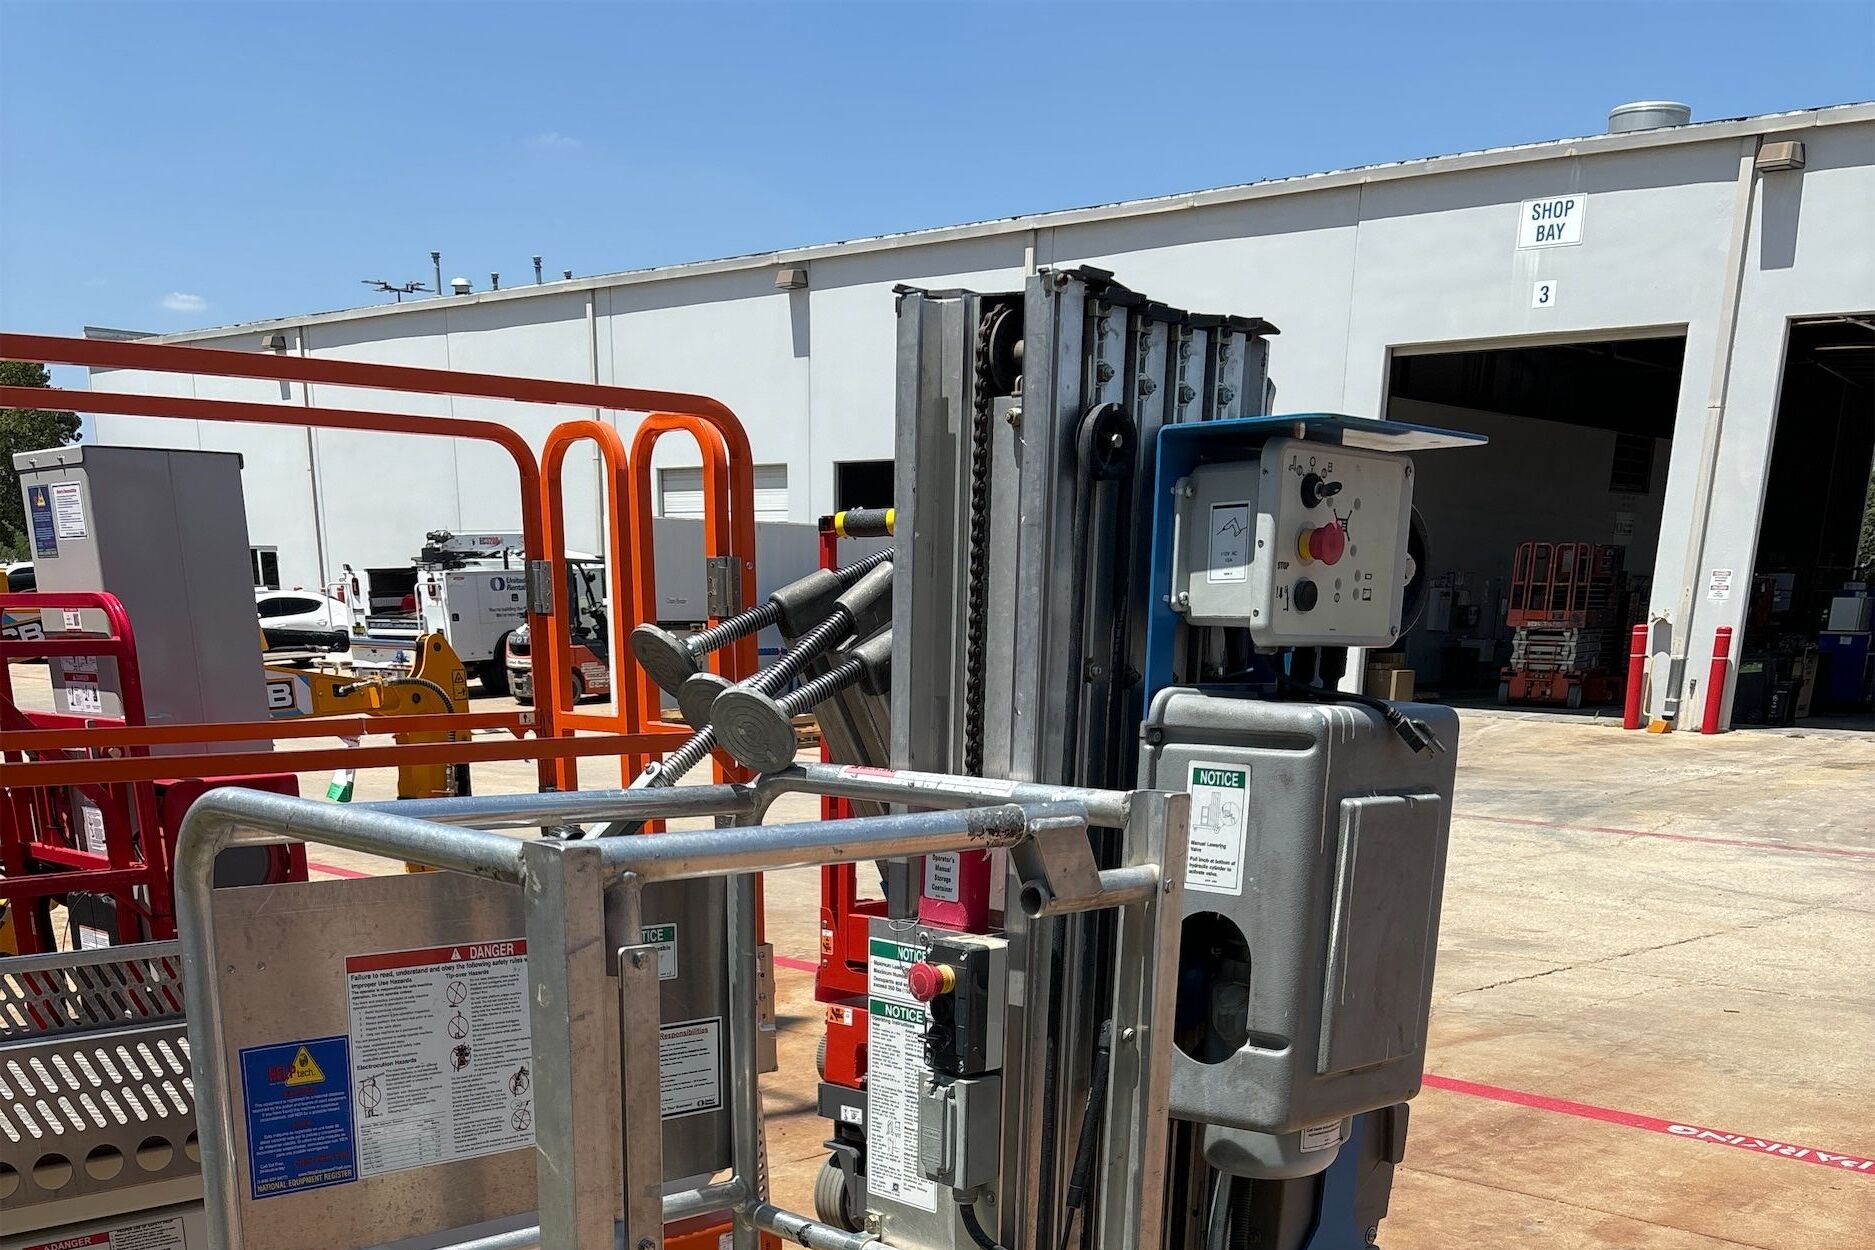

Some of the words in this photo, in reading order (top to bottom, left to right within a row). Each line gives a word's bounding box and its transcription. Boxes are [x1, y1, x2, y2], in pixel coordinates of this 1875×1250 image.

[1532, 199, 1575, 221] SHOP
[1536, 222, 1566, 242] BAY
[1539, 285, 1550, 304] 3
[1200, 770, 1239, 787] NOTICE
[641, 929, 664, 943] TICE
[469, 943, 515, 960] DANGER
[897, 946, 927, 964] NOTICE
[885, 1003, 924, 1023] NOTICE
[257, 1180, 286, 1193] NATIONAL
[324, 1169, 352, 1181] REGISTER
